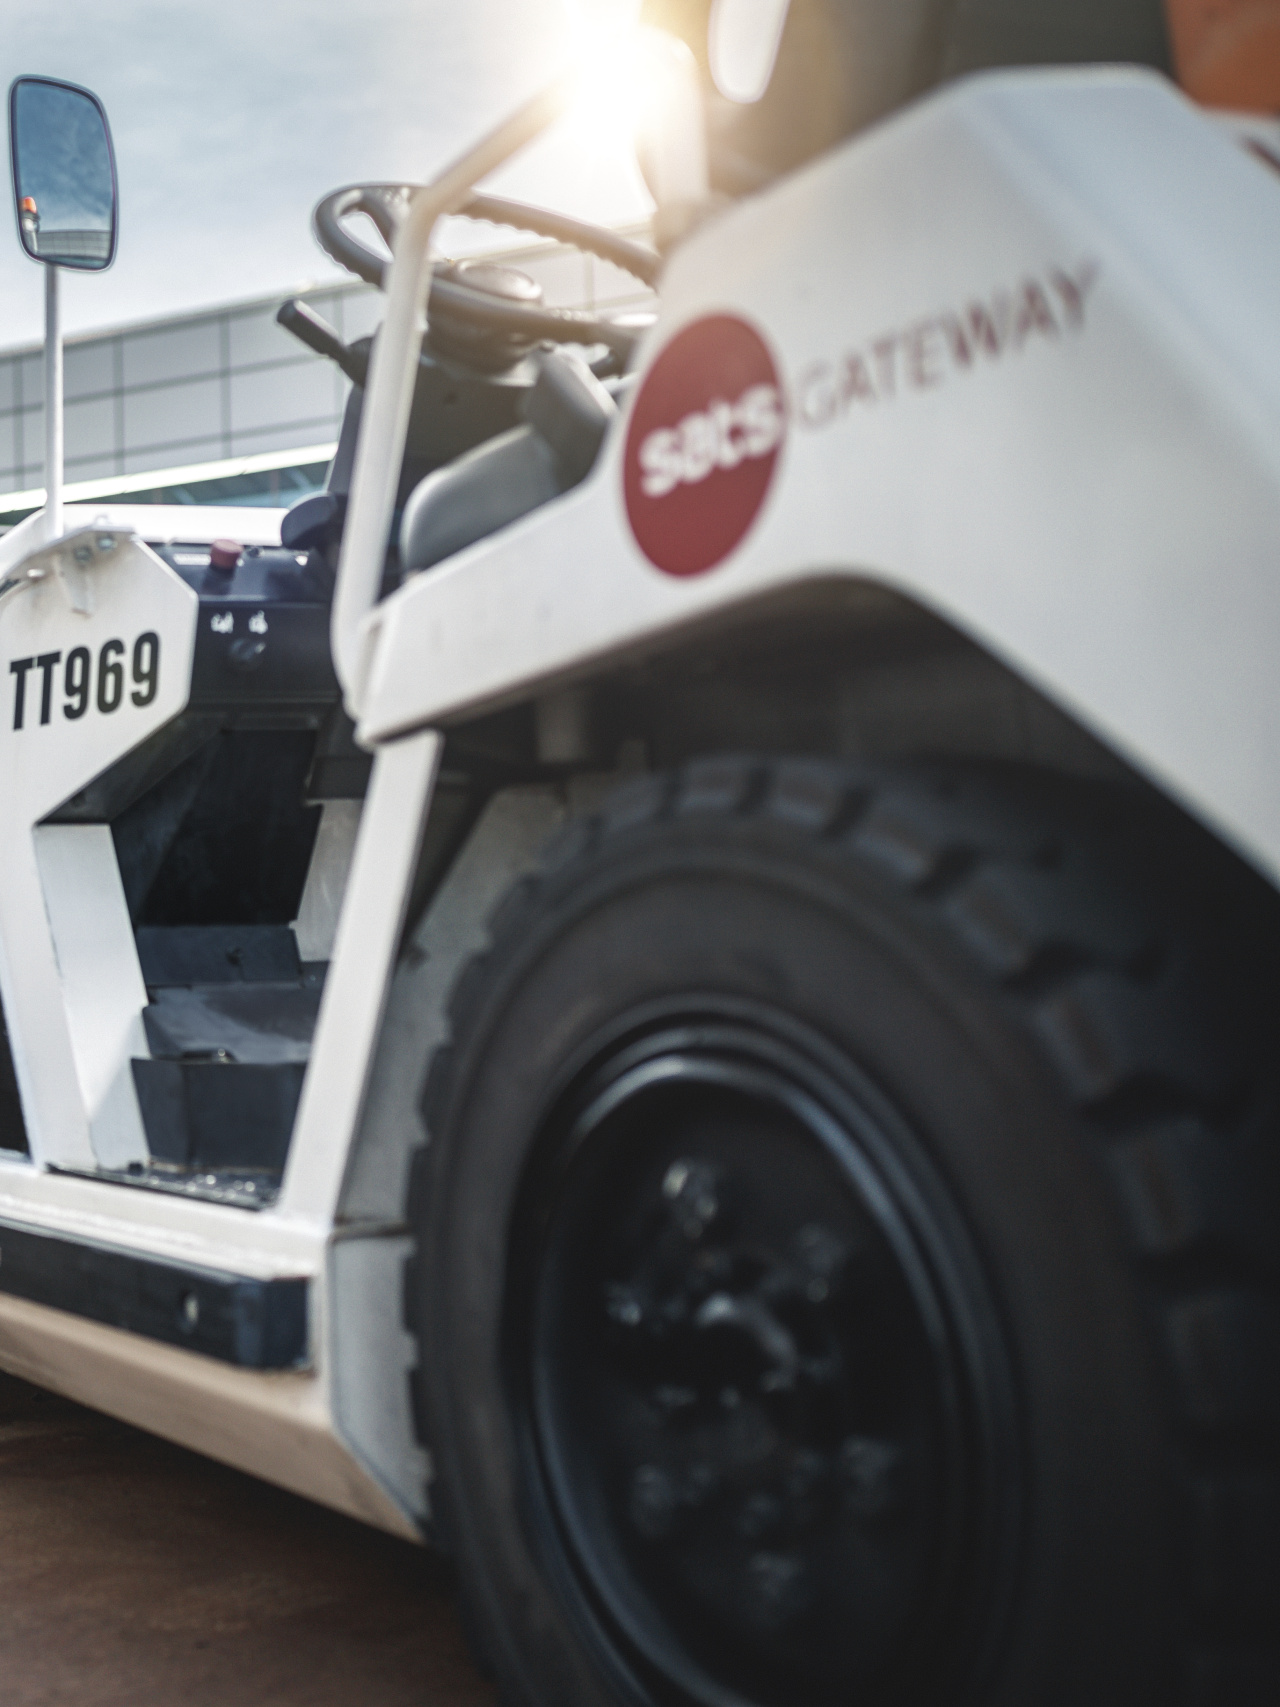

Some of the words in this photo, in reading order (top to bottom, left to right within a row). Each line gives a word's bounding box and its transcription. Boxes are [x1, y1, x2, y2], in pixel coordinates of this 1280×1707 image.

[638, 384, 784, 498] sats
[800, 259, 1100, 430] GATEWAY
[10, 631, 160, 731] TT969
